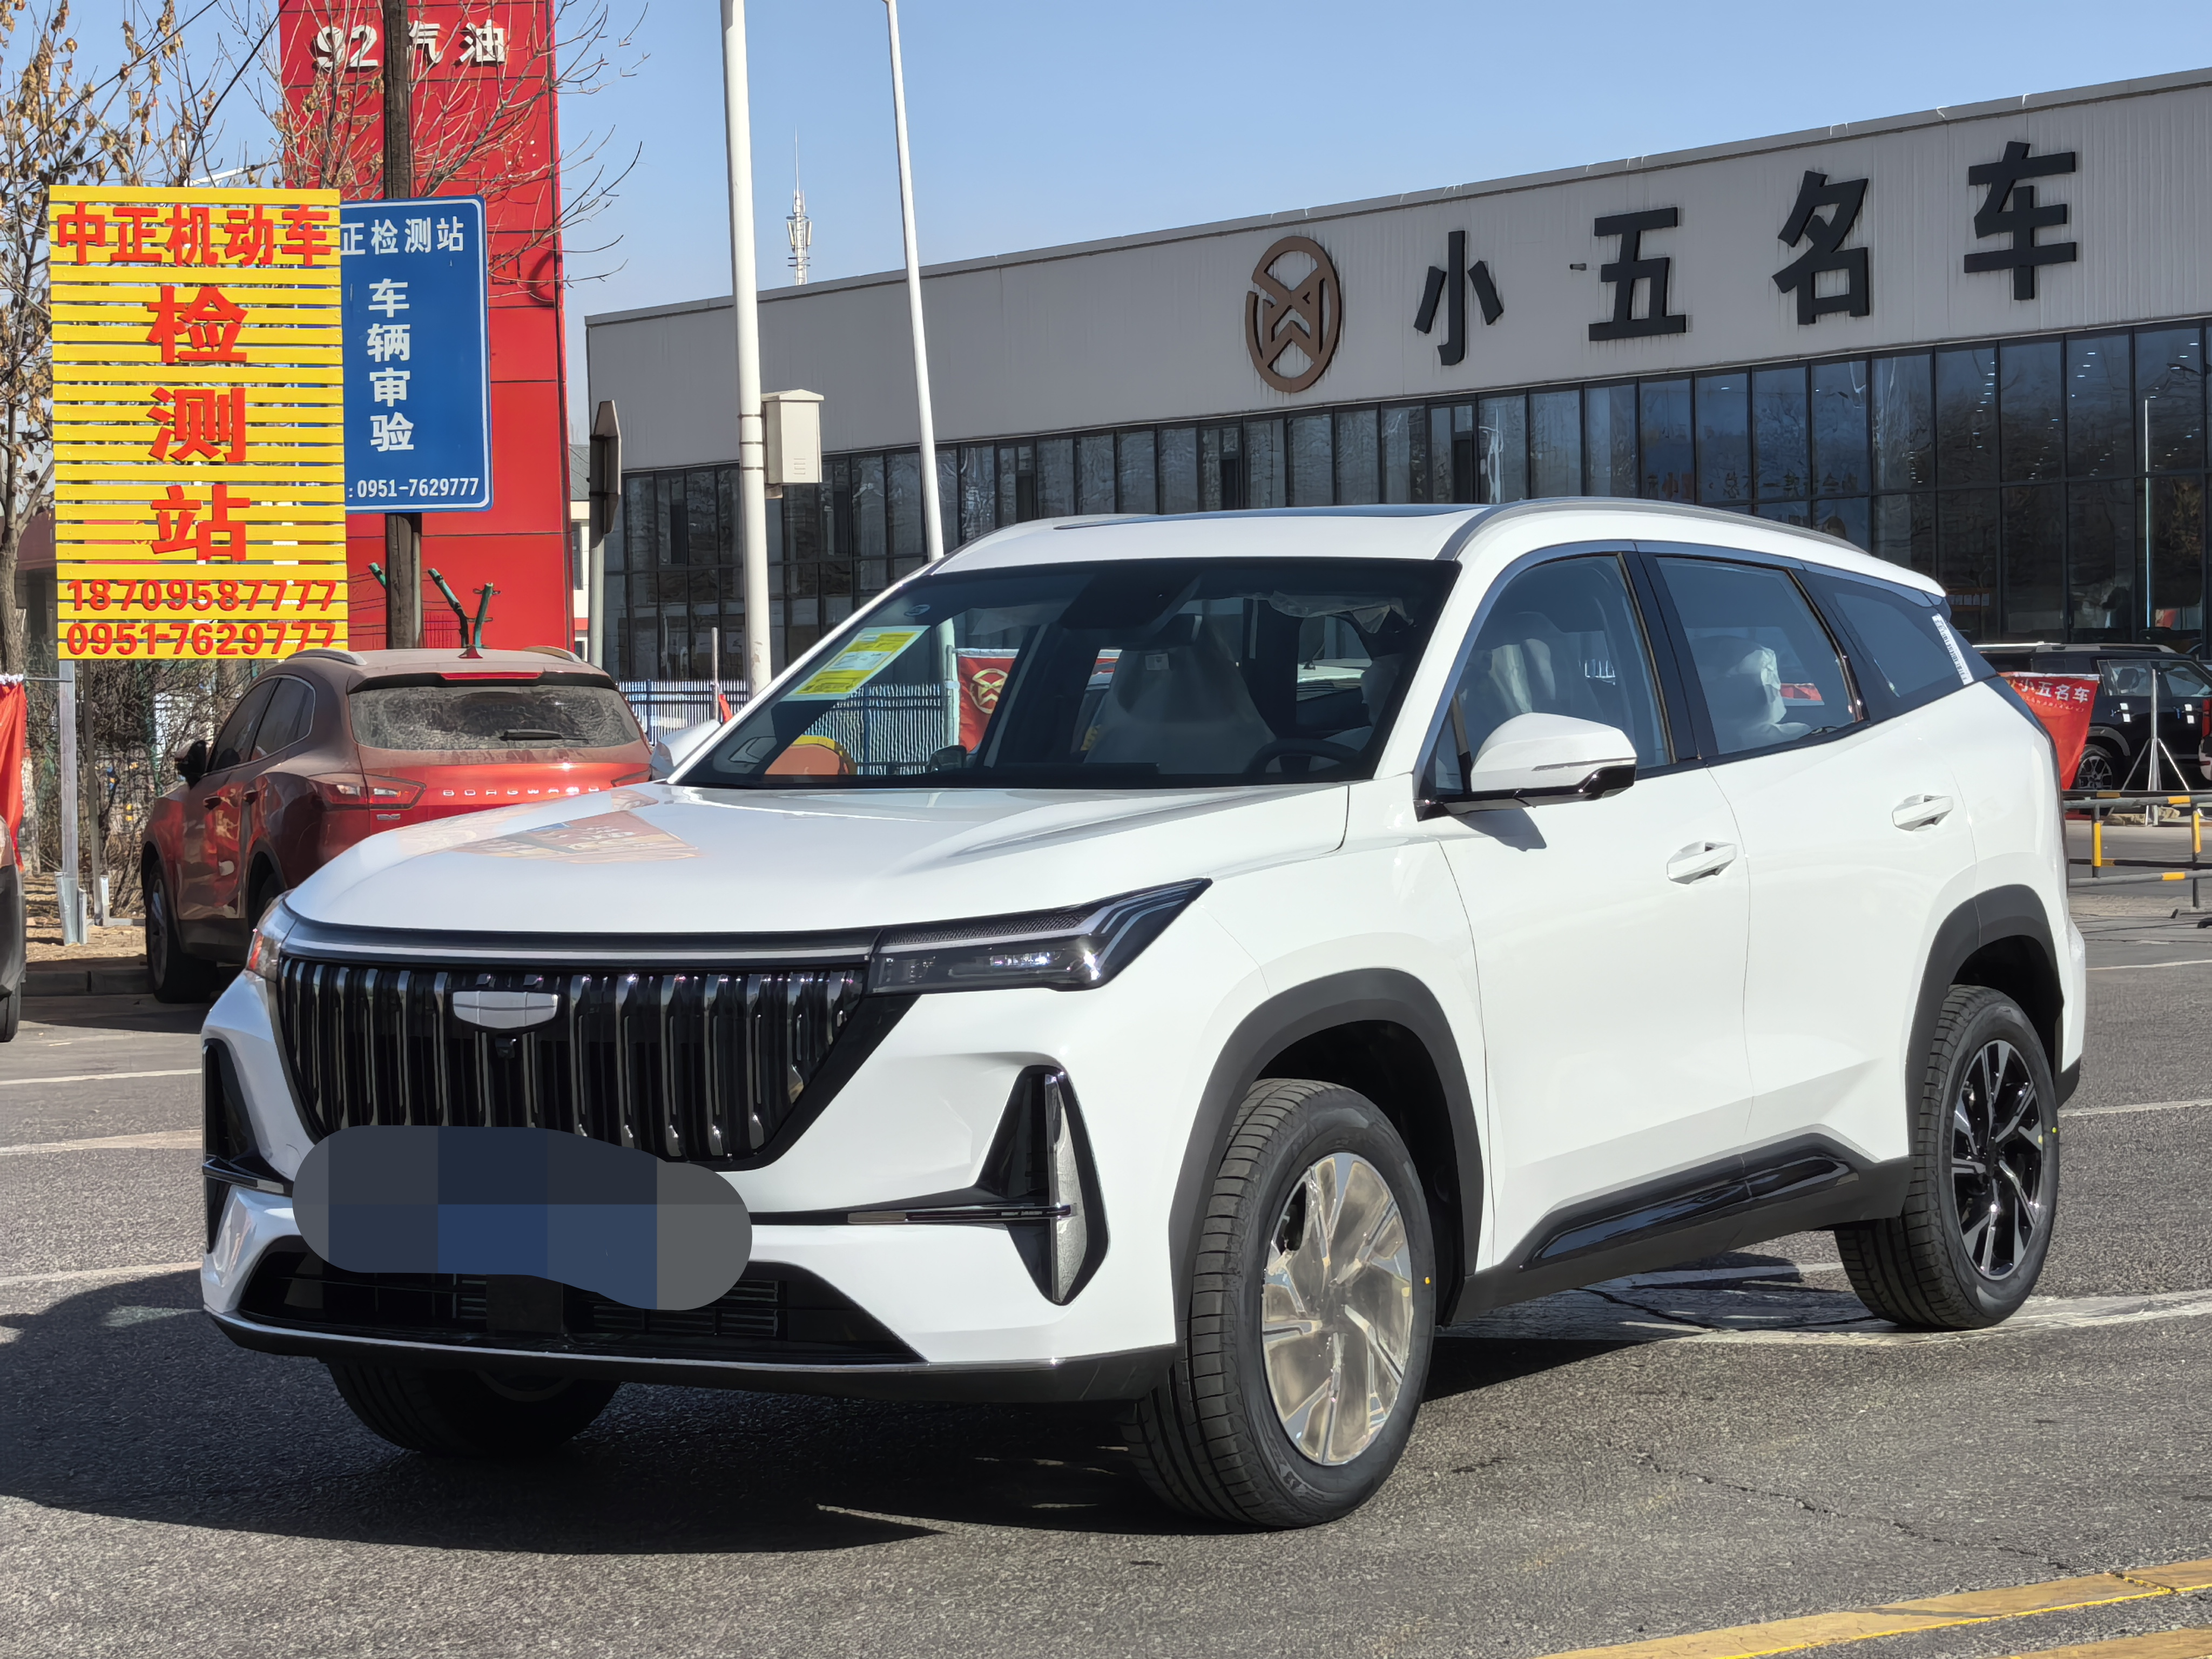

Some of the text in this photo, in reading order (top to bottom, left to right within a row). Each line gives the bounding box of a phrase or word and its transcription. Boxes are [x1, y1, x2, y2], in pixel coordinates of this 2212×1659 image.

[57, 201, 332, 266] 中正机动车
[340, 216, 464, 255] 正检测站
[1414, 141, 2077, 366] 小五名车
[367, 278, 414, 452] 车辆审验
[146, 285, 251, 561] 检测站
[67, 579, 336, 611] 18709587777
[67, 622, 336, 655] 0951-7629777
[2020, 678, 2090, 703] 小五名车
